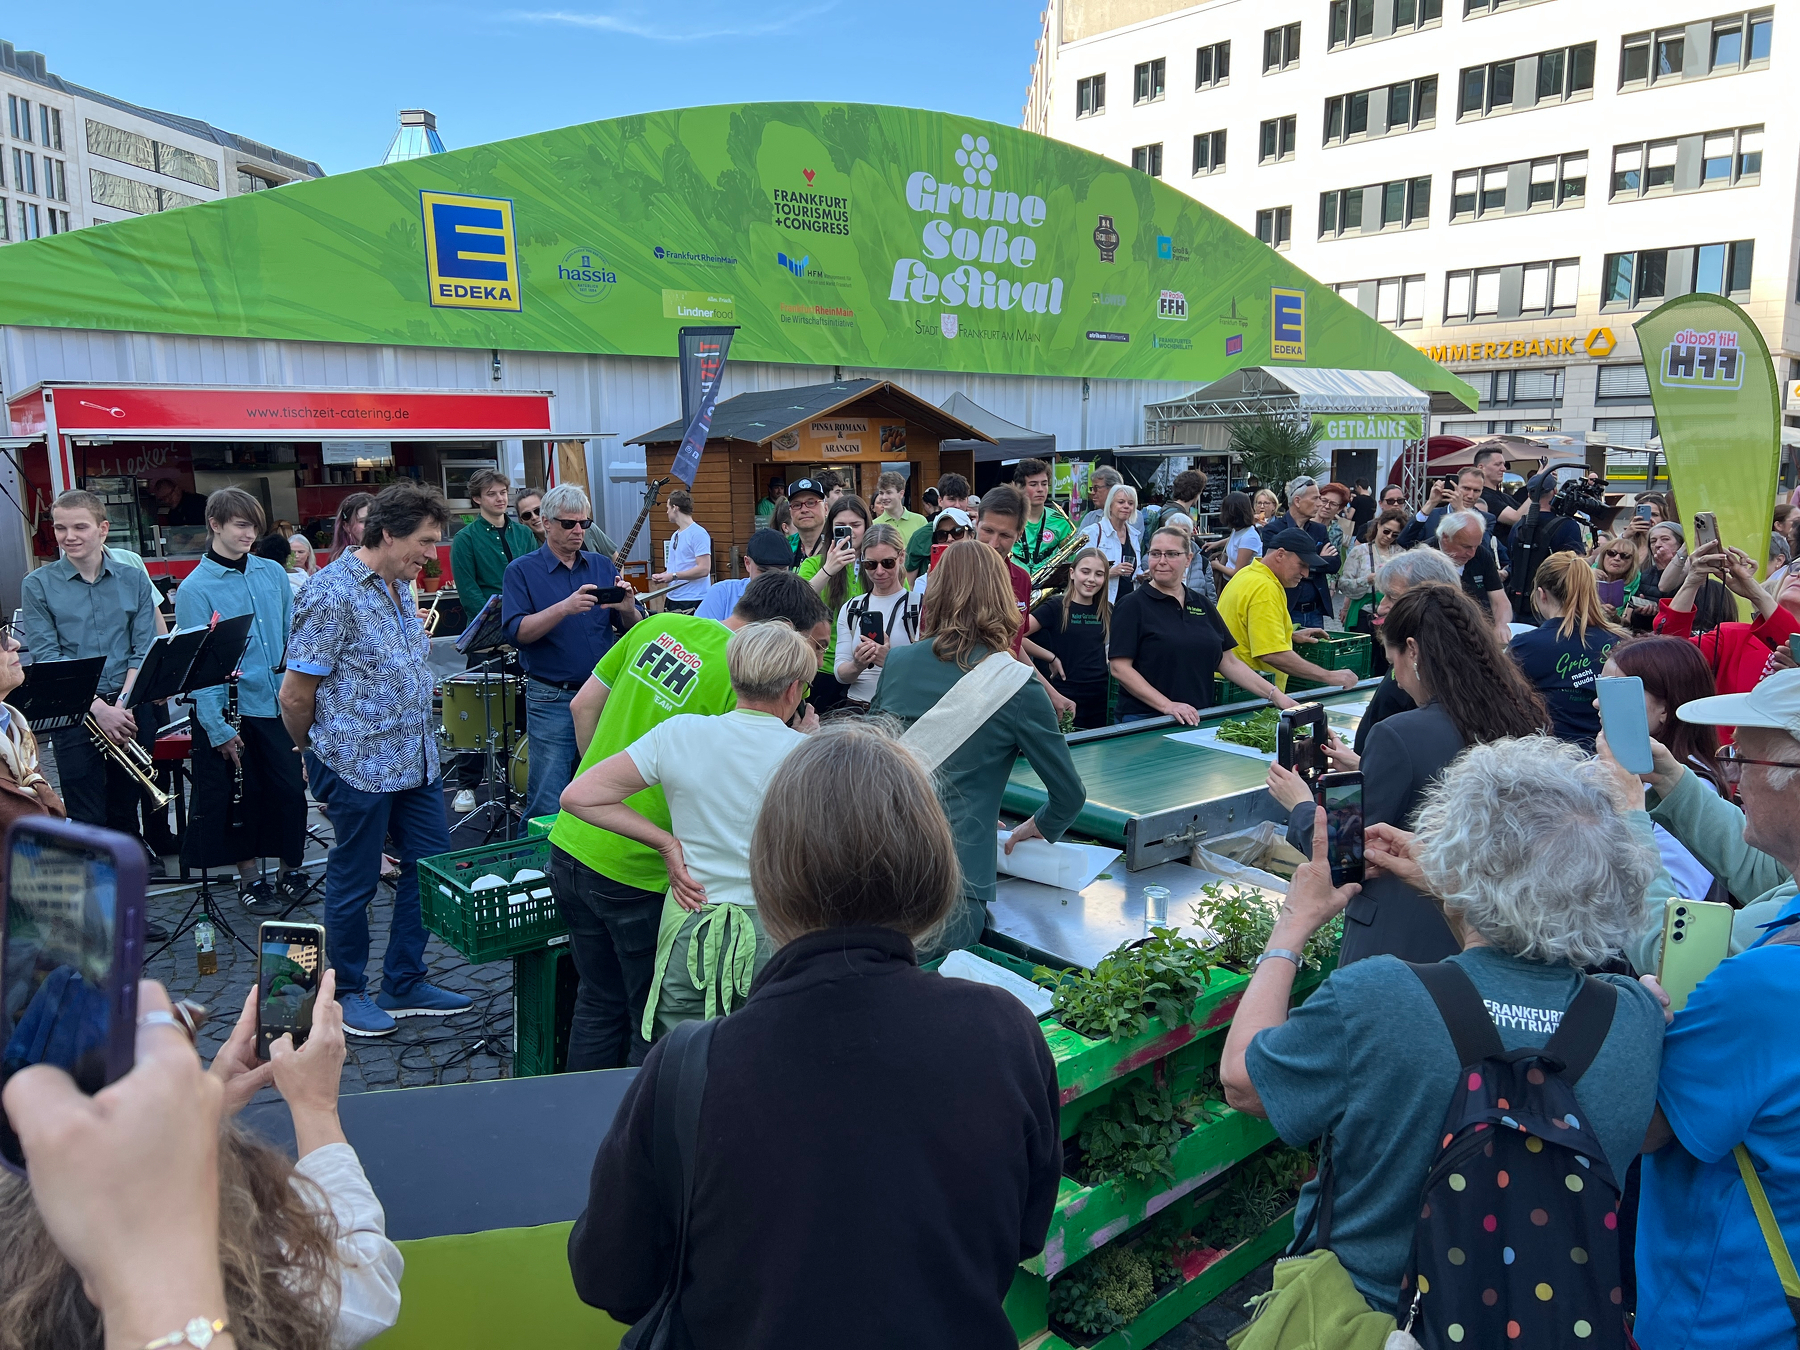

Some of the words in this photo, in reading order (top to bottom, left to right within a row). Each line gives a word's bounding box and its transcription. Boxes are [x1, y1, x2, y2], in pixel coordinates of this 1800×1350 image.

[773, 189, 848, 209] FRANKFURT
[906, 167, 1046, 227] Grüne
[774, 202, 849, 222] TOURISMUS
[775, 217, 849, 236] +CONGRESS
[922, 219, 1036, 268] Soße
[558, 264, 617, 284] hassia
[807, 269, 823, 278] HFM
[439, 284, 512, 301] EDEKA
[1161, 290, 1169, 298] Hit
[1169, 290, 1184, 300] Radio
[677, 305, 734, 320] Lindnerfood
[780, 302, 854, 318] FrankfurtRheinMain
[1160, 298, 1185, 316] FFH
[780, 314, 791, 324] Die
[792, 315, 854, 328] Wirtschaftsinitiative
[1274, 345, 1303, 356] EDEKA
[1416, 336, 1577, 363] MMERZBANK
[246, 406, 410, 422] www.tischzeit-catering.de
[811, 422, 834, 432] PINSA
[834, 422, 867, 432] ROMANA
[837, 431, 843, 439] &
[1327, 415, 1406, 439] GETRÄNKE
[824, 444, 860, 453] ARANCINI
[656, 633, 675, 650] Hit
[669, 643, 702, 669] Radio
[635, 642, 697, 696] FFH
[1555, 652, 1591, 679] Grie
[1571, 668, 1593, 680] macht
[654, 694, 673, 712] EAM
[1488, 1011, 1560, 1034] ITYTRIAT
